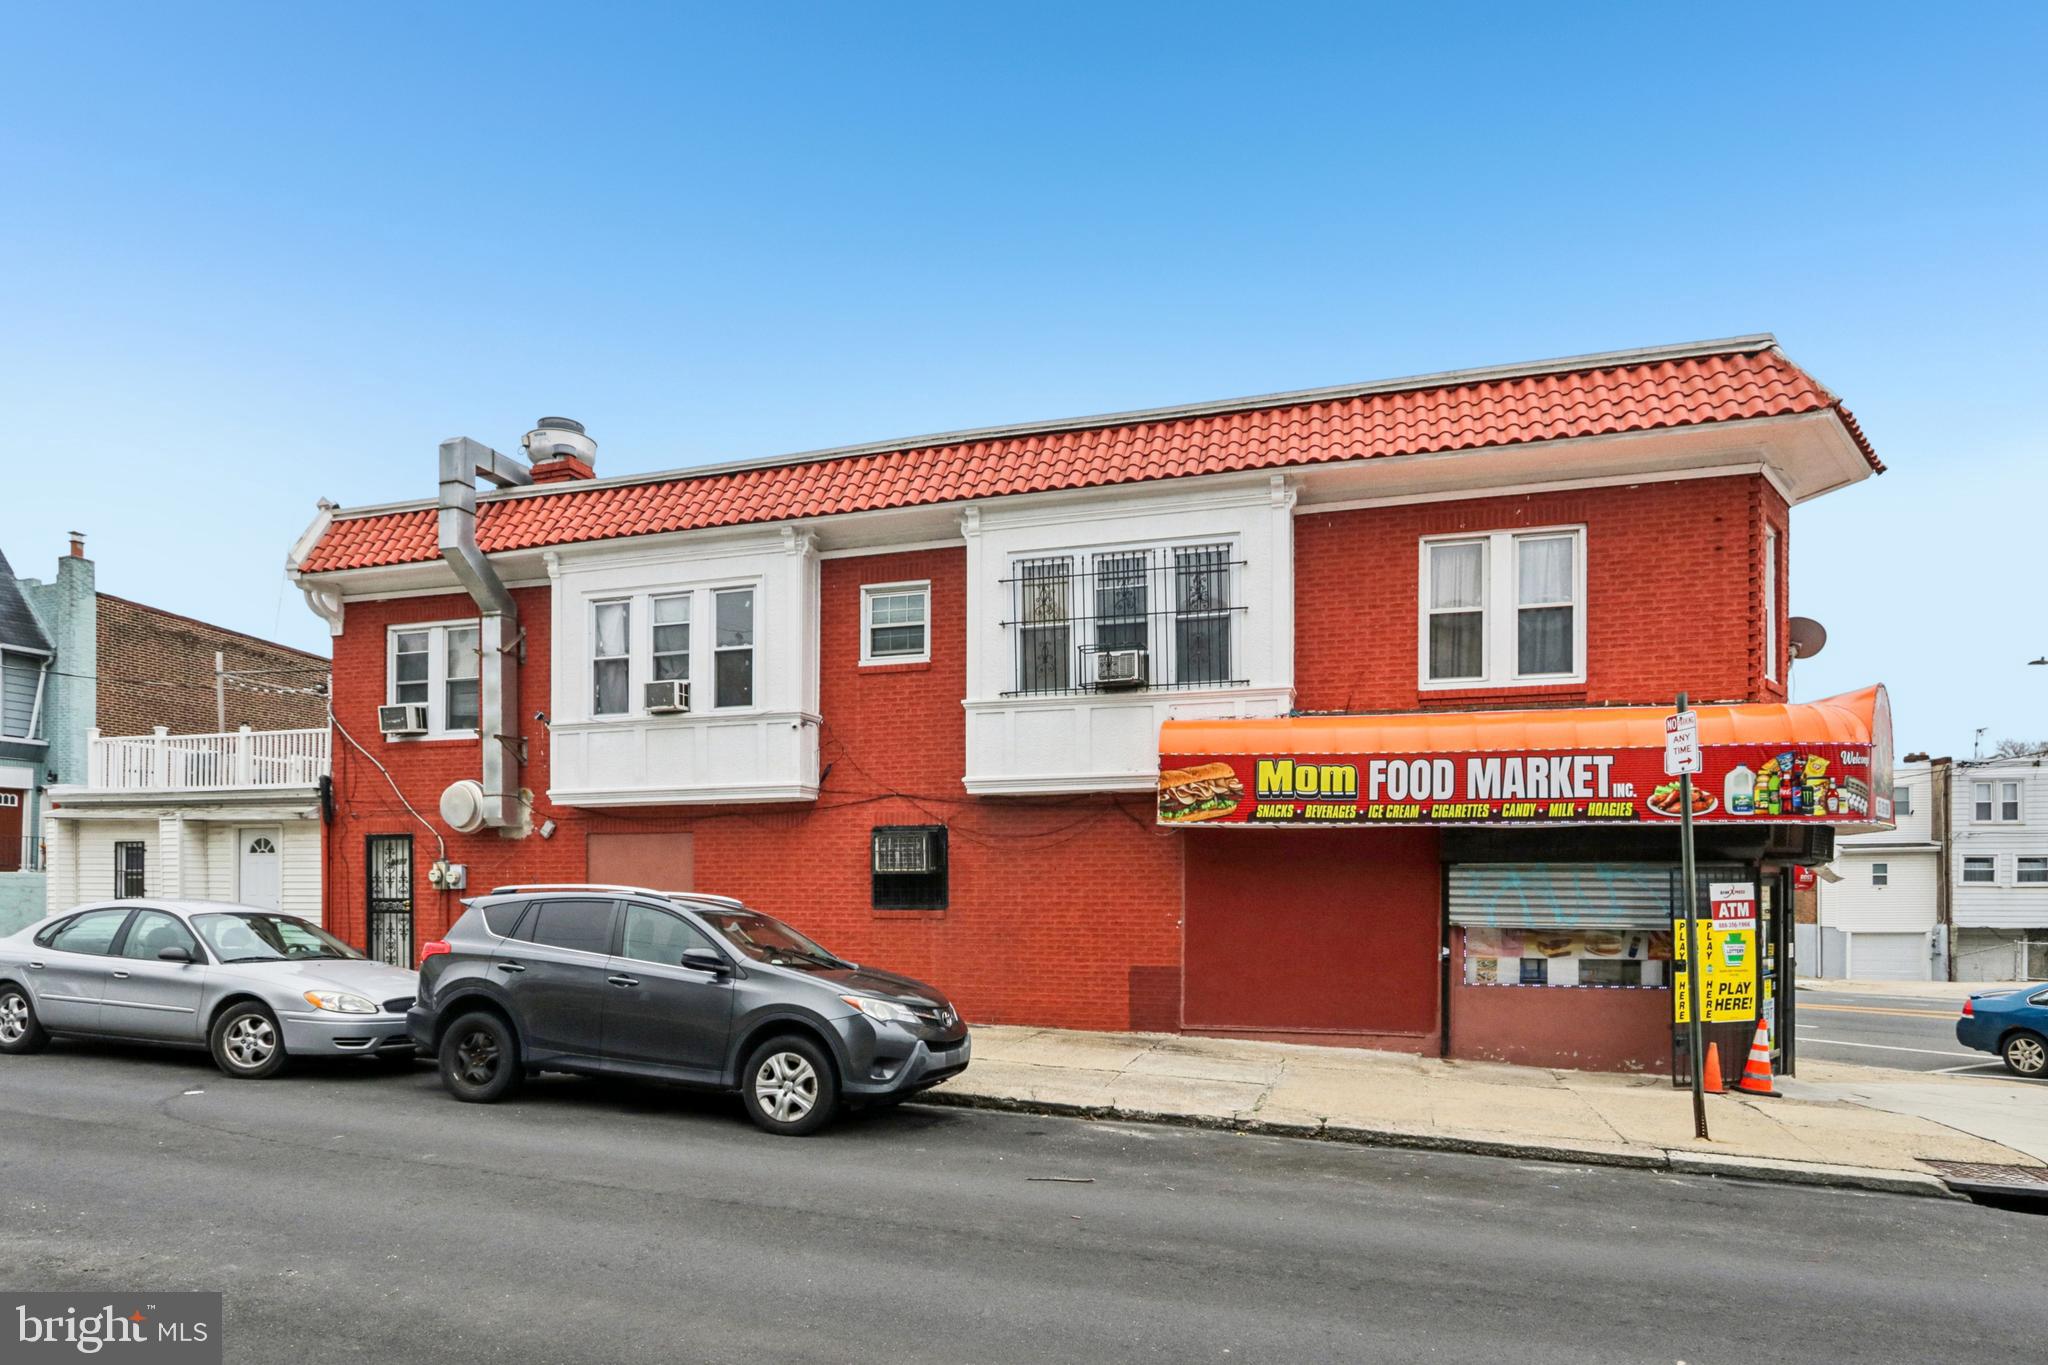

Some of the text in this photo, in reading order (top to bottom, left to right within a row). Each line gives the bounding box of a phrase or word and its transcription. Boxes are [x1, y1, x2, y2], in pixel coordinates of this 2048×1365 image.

[1667, 718, 1677, 731] NO
[1673, 733, 1690, 743] ANY
[1673, 745, 1692, 755] TIME
[1257, 756, 1637, 800] Mom FOOD MARKET INC.
[1256, 802, 1633, 819] SNACKS BEVERAGES ICE CREAM CIGARETTES CANDY MILK HOAGIES
[1718, 902, 1750, 918] ATM
[1719, 982, 1751, 995] PLAY
[1715, 997, 1753, 1011] HERE!
